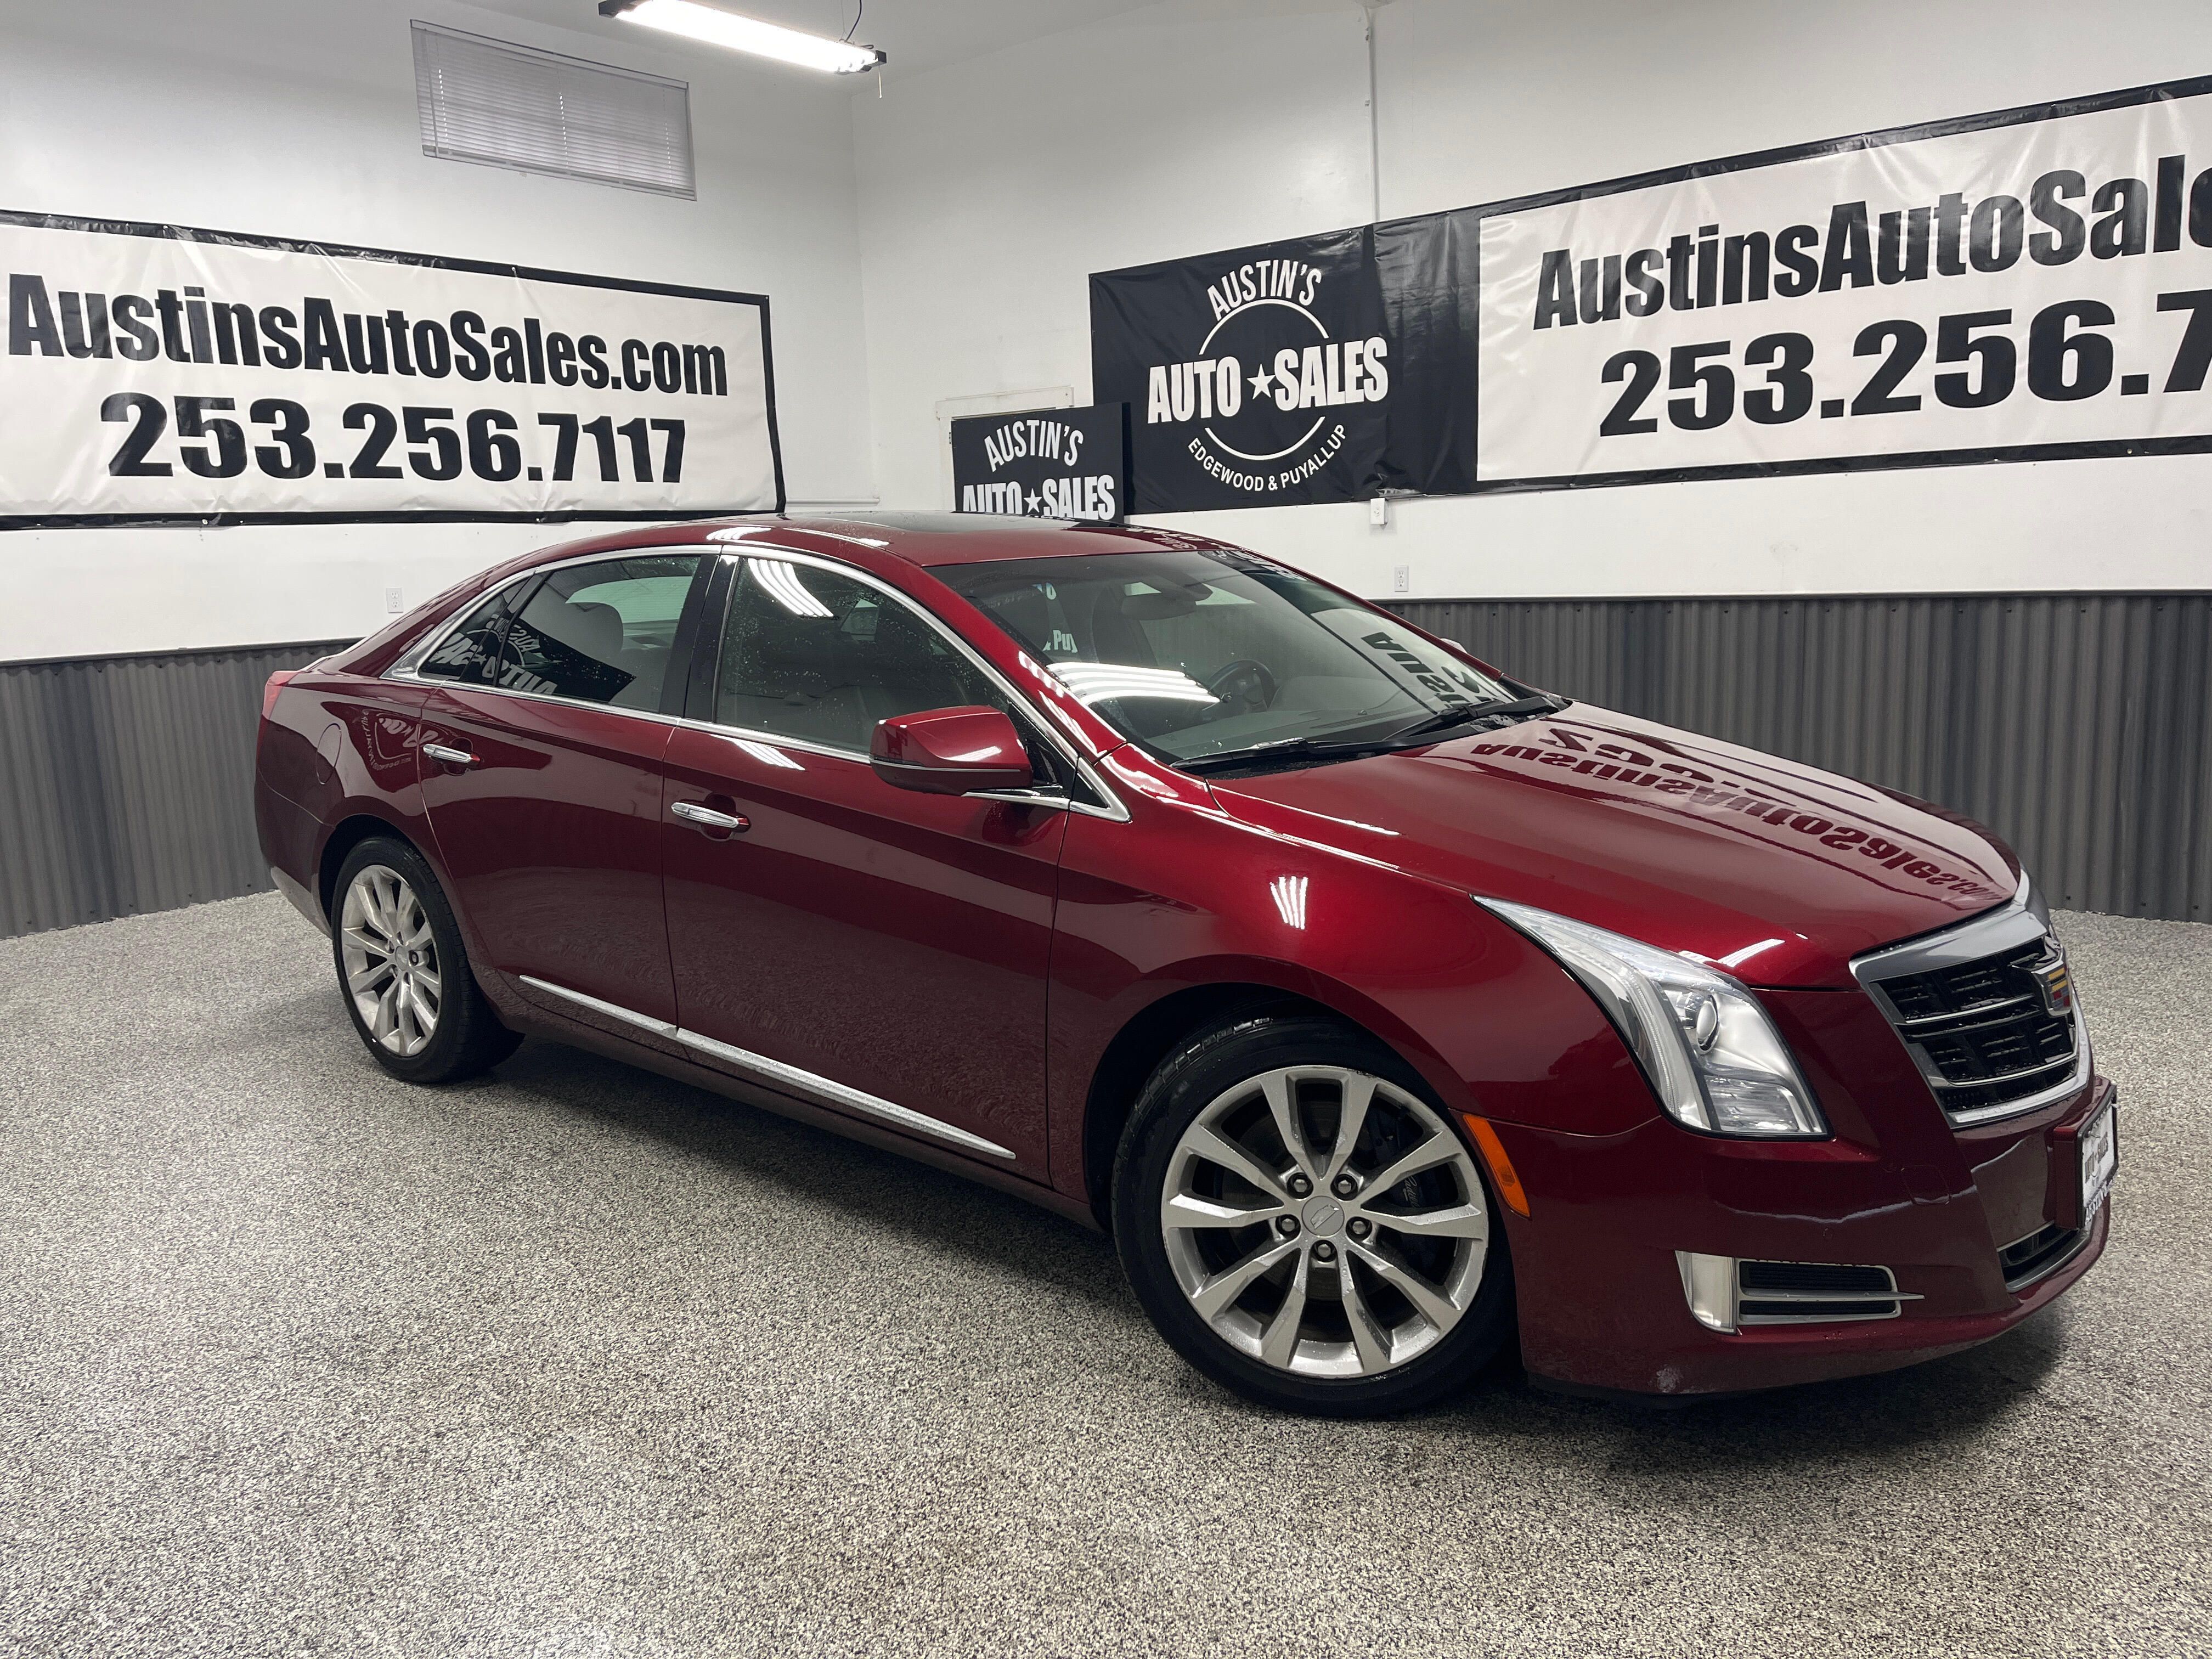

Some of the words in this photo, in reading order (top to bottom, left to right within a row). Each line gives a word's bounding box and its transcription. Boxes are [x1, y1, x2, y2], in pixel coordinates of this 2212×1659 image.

[1207, 259, 1322, 321] AUSTIN'S
[8, 274, 728, 396] AustinsAutoSales.com
[1600, 289, 2212, 437] 253.256.7
[1148, 356, 1242, 424] AUTO
[1274, 337, 1389, 411] SALES
[100, 392, 686, 483] 253.256.7117
[984, 420, 1084, 472] AUSTIN'S
[1188, 437, 1264, 492] EDGEWOOD
[1268, 475, 1278, 491] &
[1280, 424, 1346, 488] PUYALLUP
[963, 481, 1023, 515] AUTO
[1042, 475, 1115, 521] SALES
